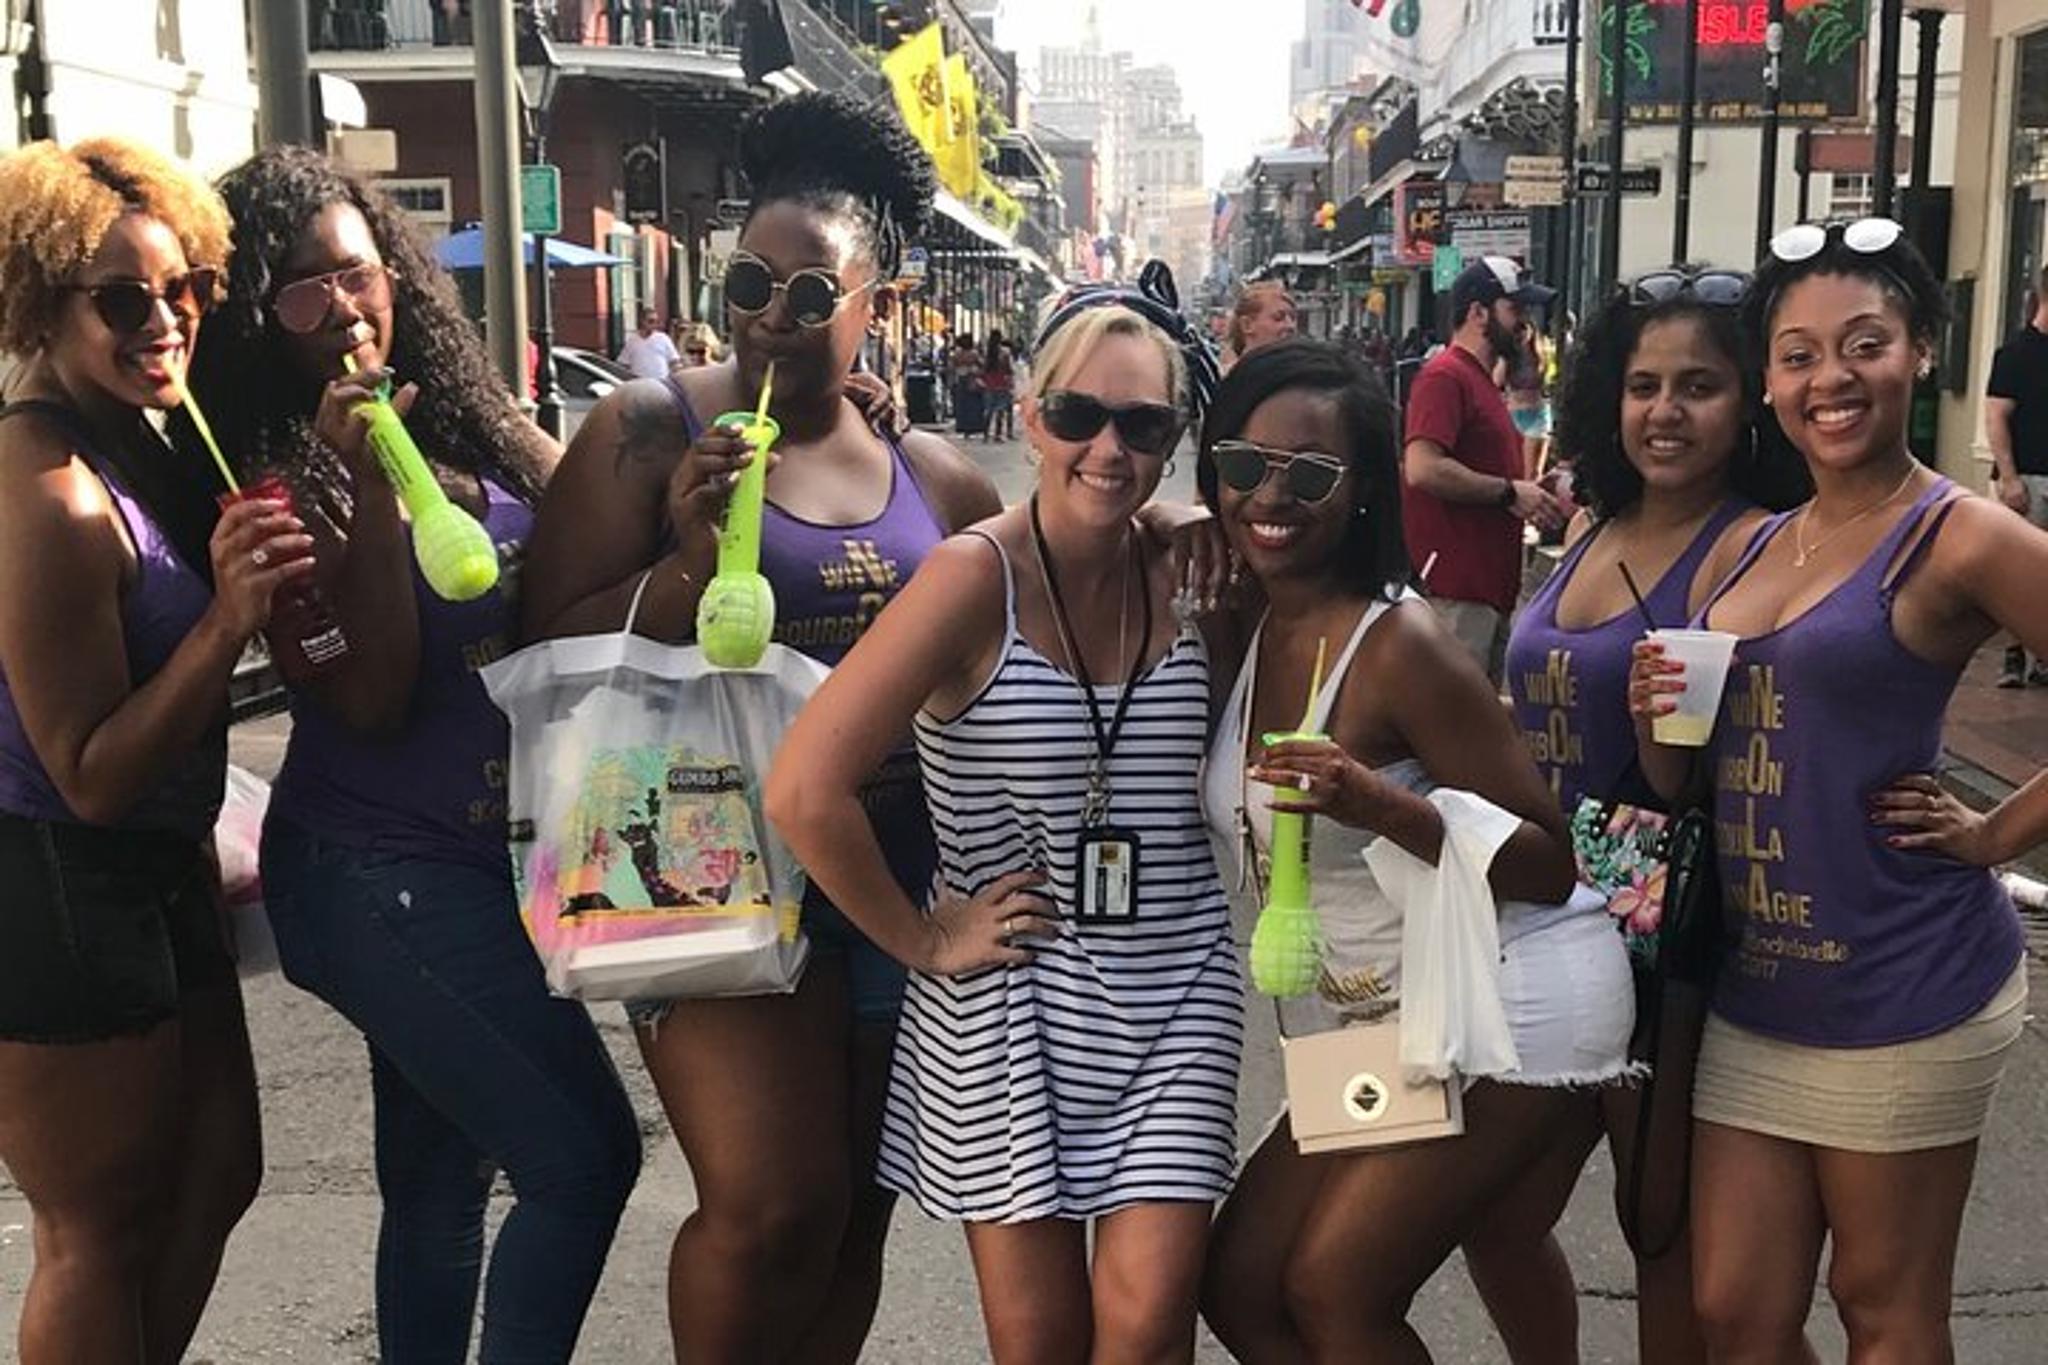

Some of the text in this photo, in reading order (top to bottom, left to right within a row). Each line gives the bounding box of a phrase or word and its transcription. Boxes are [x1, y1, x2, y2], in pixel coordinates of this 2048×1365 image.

[1697, 3, 1767, 44] ISLE
[819, 540, 896, 589] WINE
[1524, 649, 1578, 706] WINE
[1727, 664, 1784, 730] WINE
[671, 769, 719, 786] GUMBO
